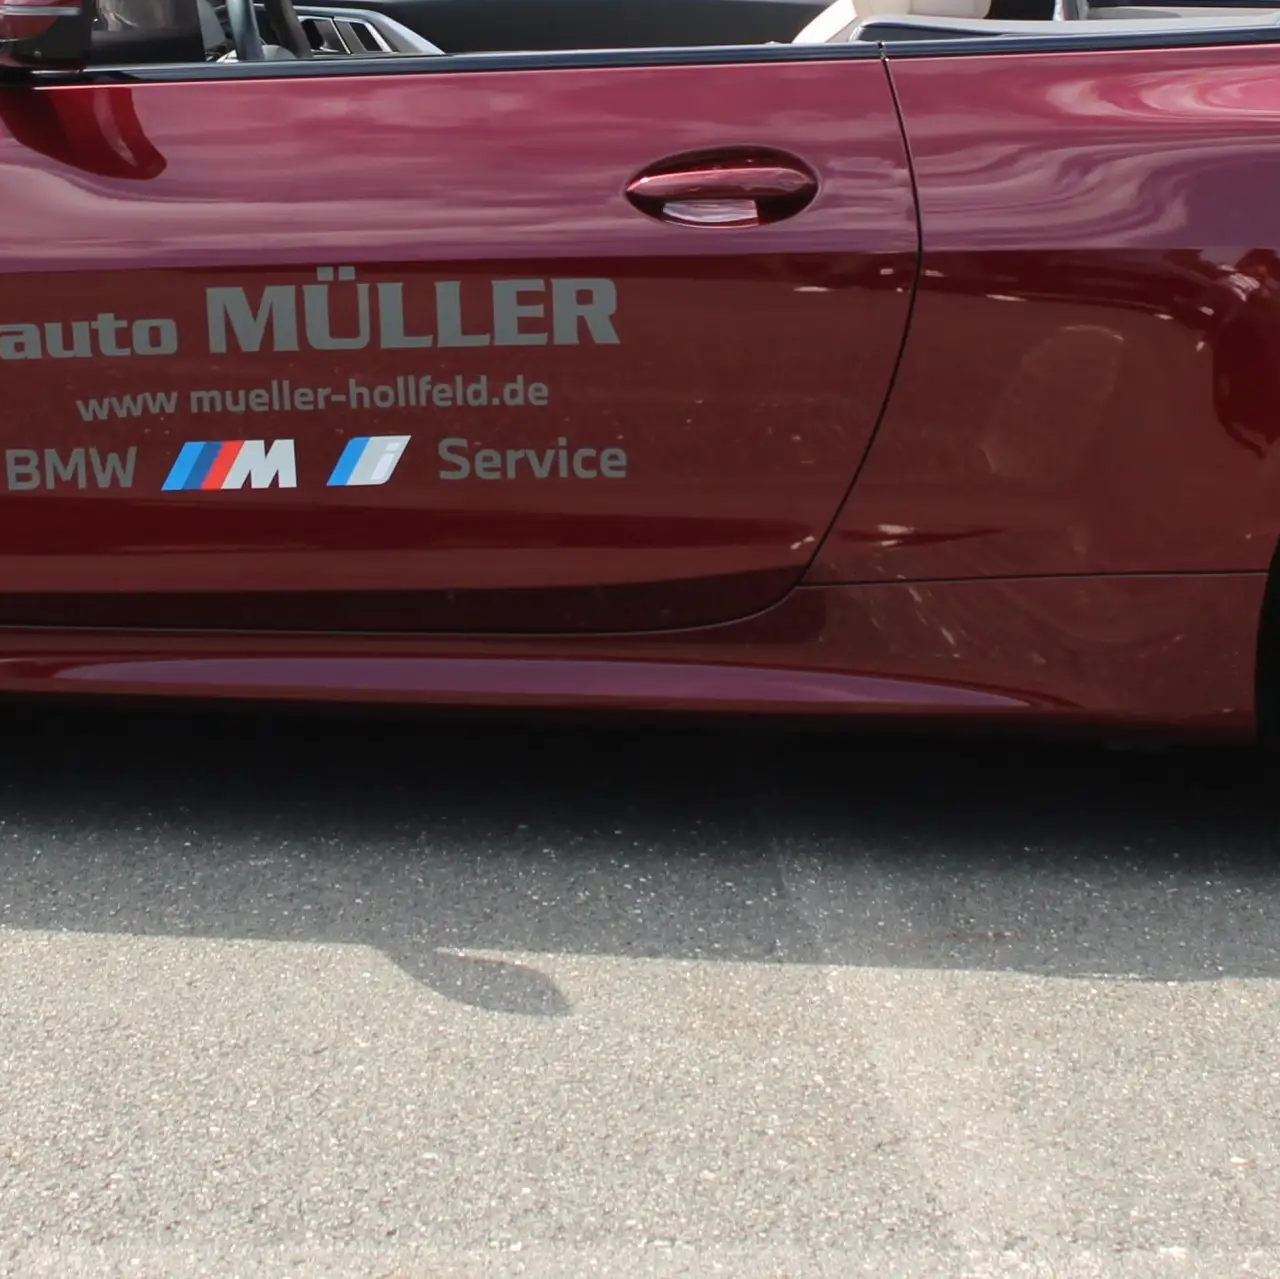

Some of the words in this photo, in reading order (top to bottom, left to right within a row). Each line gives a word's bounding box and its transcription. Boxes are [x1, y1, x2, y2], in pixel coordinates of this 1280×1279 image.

[206, 266, 620, 355] MÜLLER
[5, 445, 138, 491] BMW
[437, 436, 628, 482] Service
